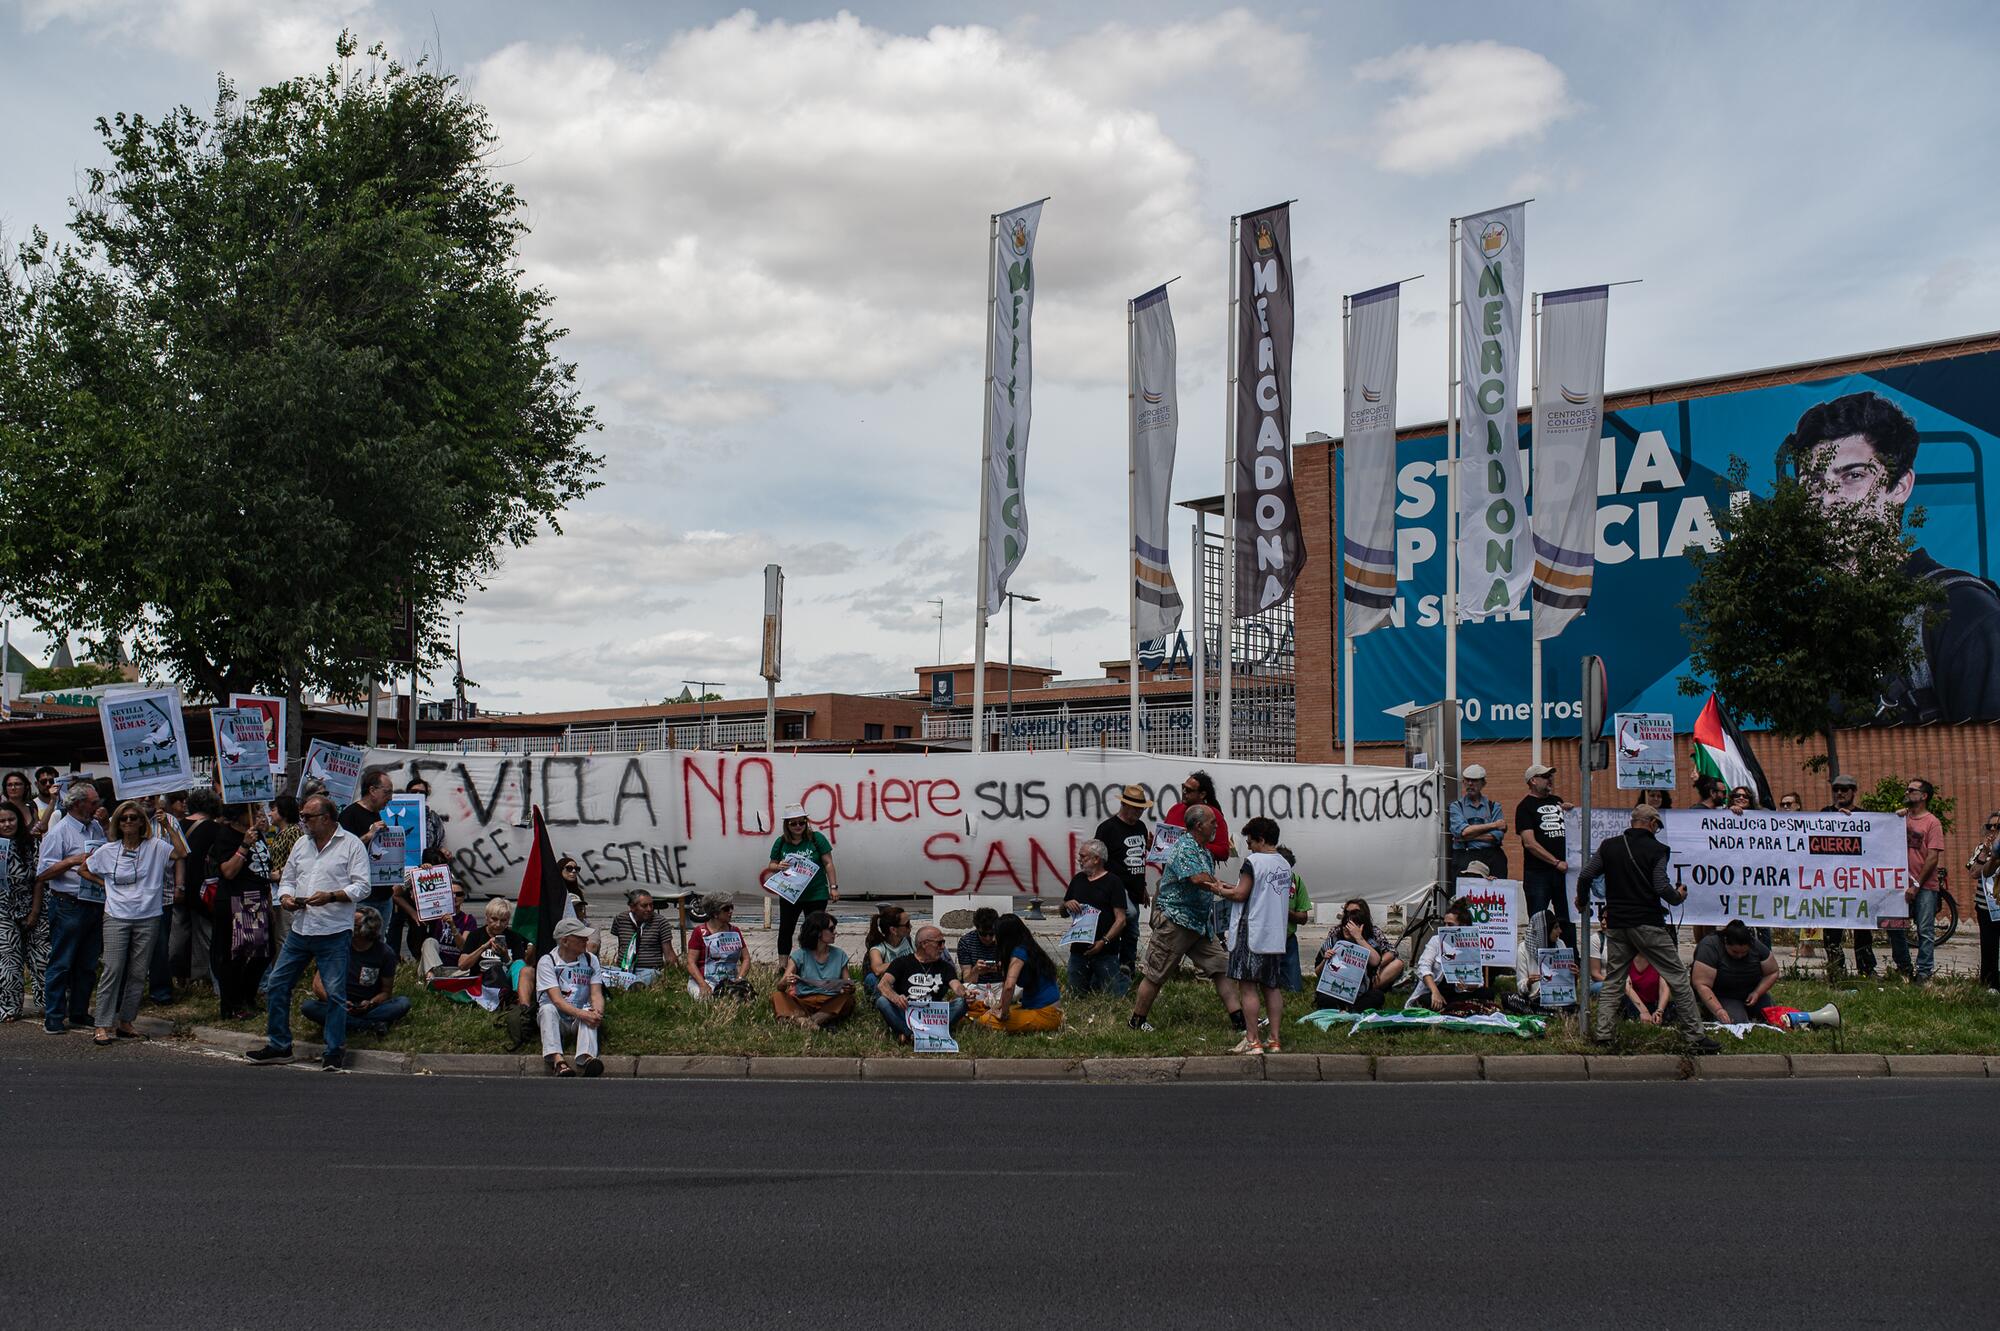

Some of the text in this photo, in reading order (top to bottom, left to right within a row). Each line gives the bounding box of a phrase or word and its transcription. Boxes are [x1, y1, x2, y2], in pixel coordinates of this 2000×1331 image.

[1253, 259, 1286, 609] MERCADONA
[1477, 261, 1515, 611] MERCADONA
[112, 706, 143, 717] SEVILLA
[114, 719, 147, 731] ARMAS
[1639, 732, 1672, 740] ARMAS
[683, 755, 775, 840] NO
[800, 769, 962, 845] quiere
[975, 780, 1050, 819] sus
[1231, 774, 1434, 822] manchadas
[1709, 835, 1744, 850] NADA
[1750, 835, 1782, 850] PARA
[1786, 836, 1805, 852] LA
[1673, 864, 1906, 892] TODO PARA LA GENTE
[1720, 895, 1868, 919] Y EL PLANETA
[1480, 937, 1494, 949] NO
